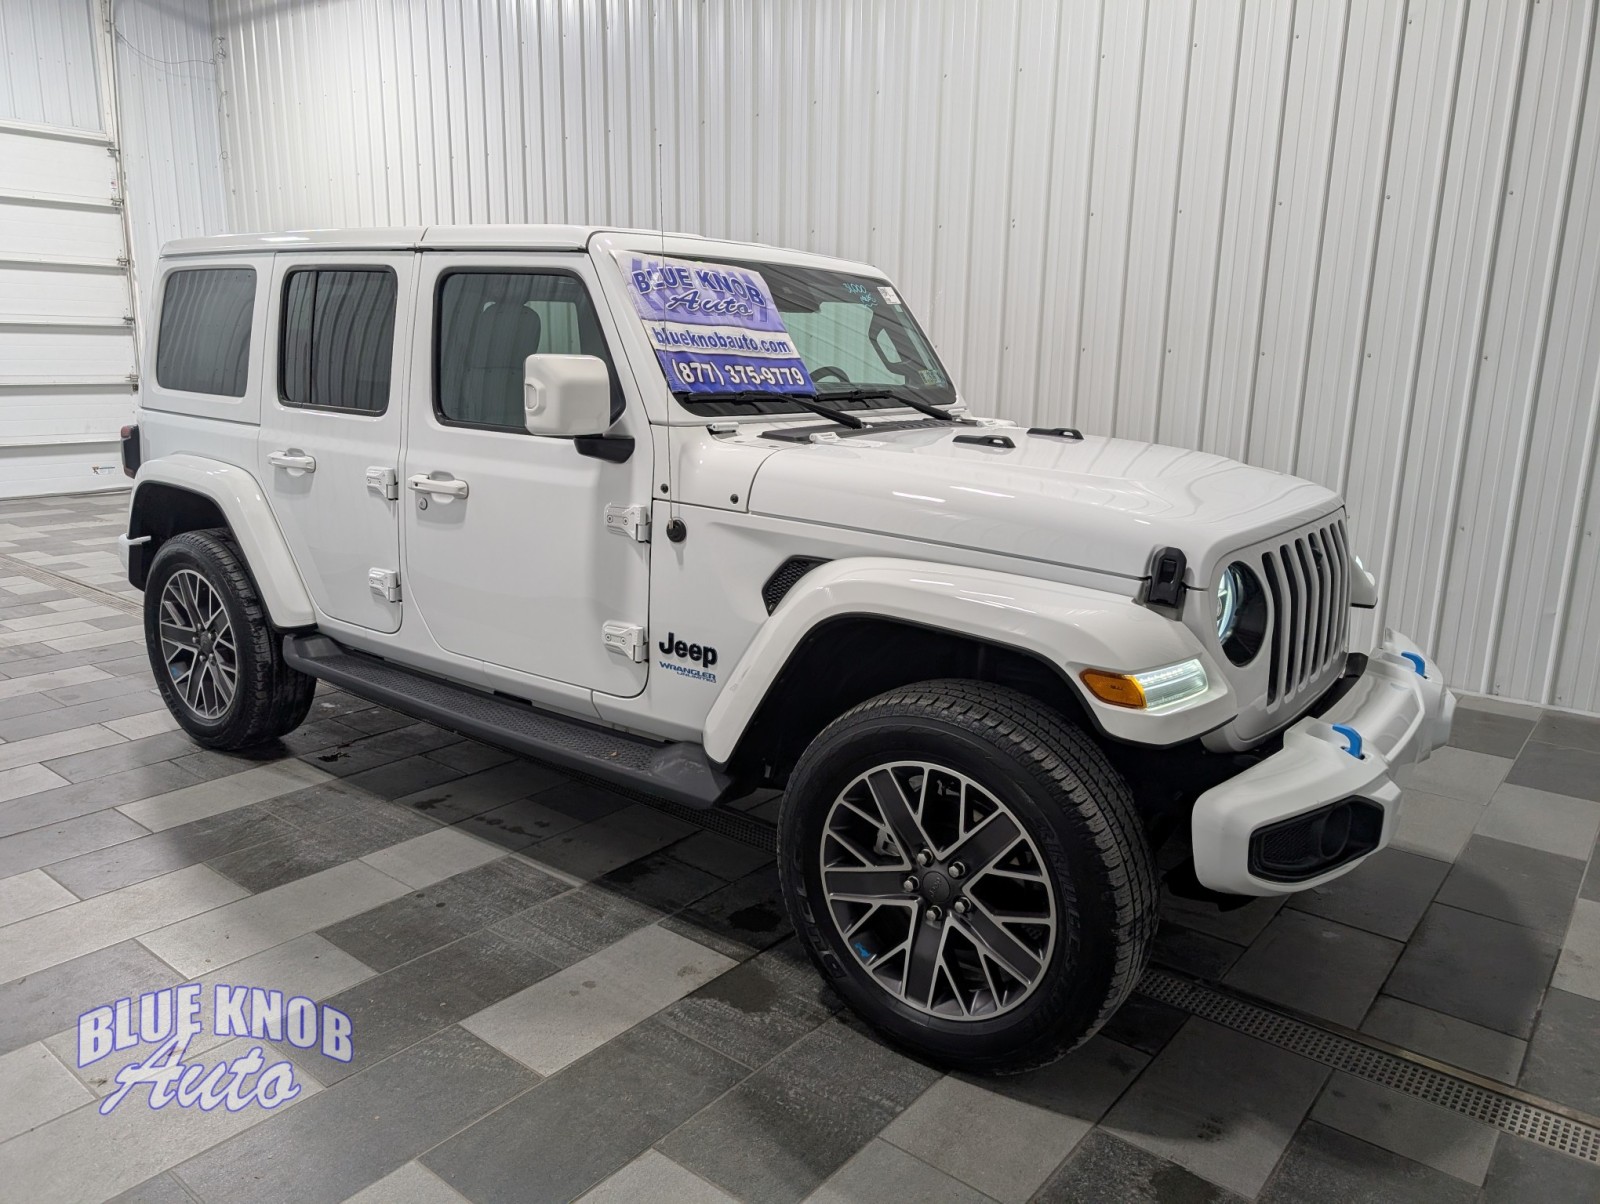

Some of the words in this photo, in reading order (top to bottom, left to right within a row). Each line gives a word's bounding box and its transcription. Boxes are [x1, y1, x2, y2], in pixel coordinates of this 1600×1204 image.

[632, 266, 694, 295] BLUE
[694, 269, 767, 307] KNOB
[666, 290, 753, 316] Auto
[651, 326, 792, 354] blueknobauto.com
[671, 358, 725, 386] (877)
[724, 364, 806, 386] 375-9779
[659, 632, 718, 668] Jeep
[659, 661, 717, 681] WRANGLER
[676, 671, 717, 684] UNLIMITED
